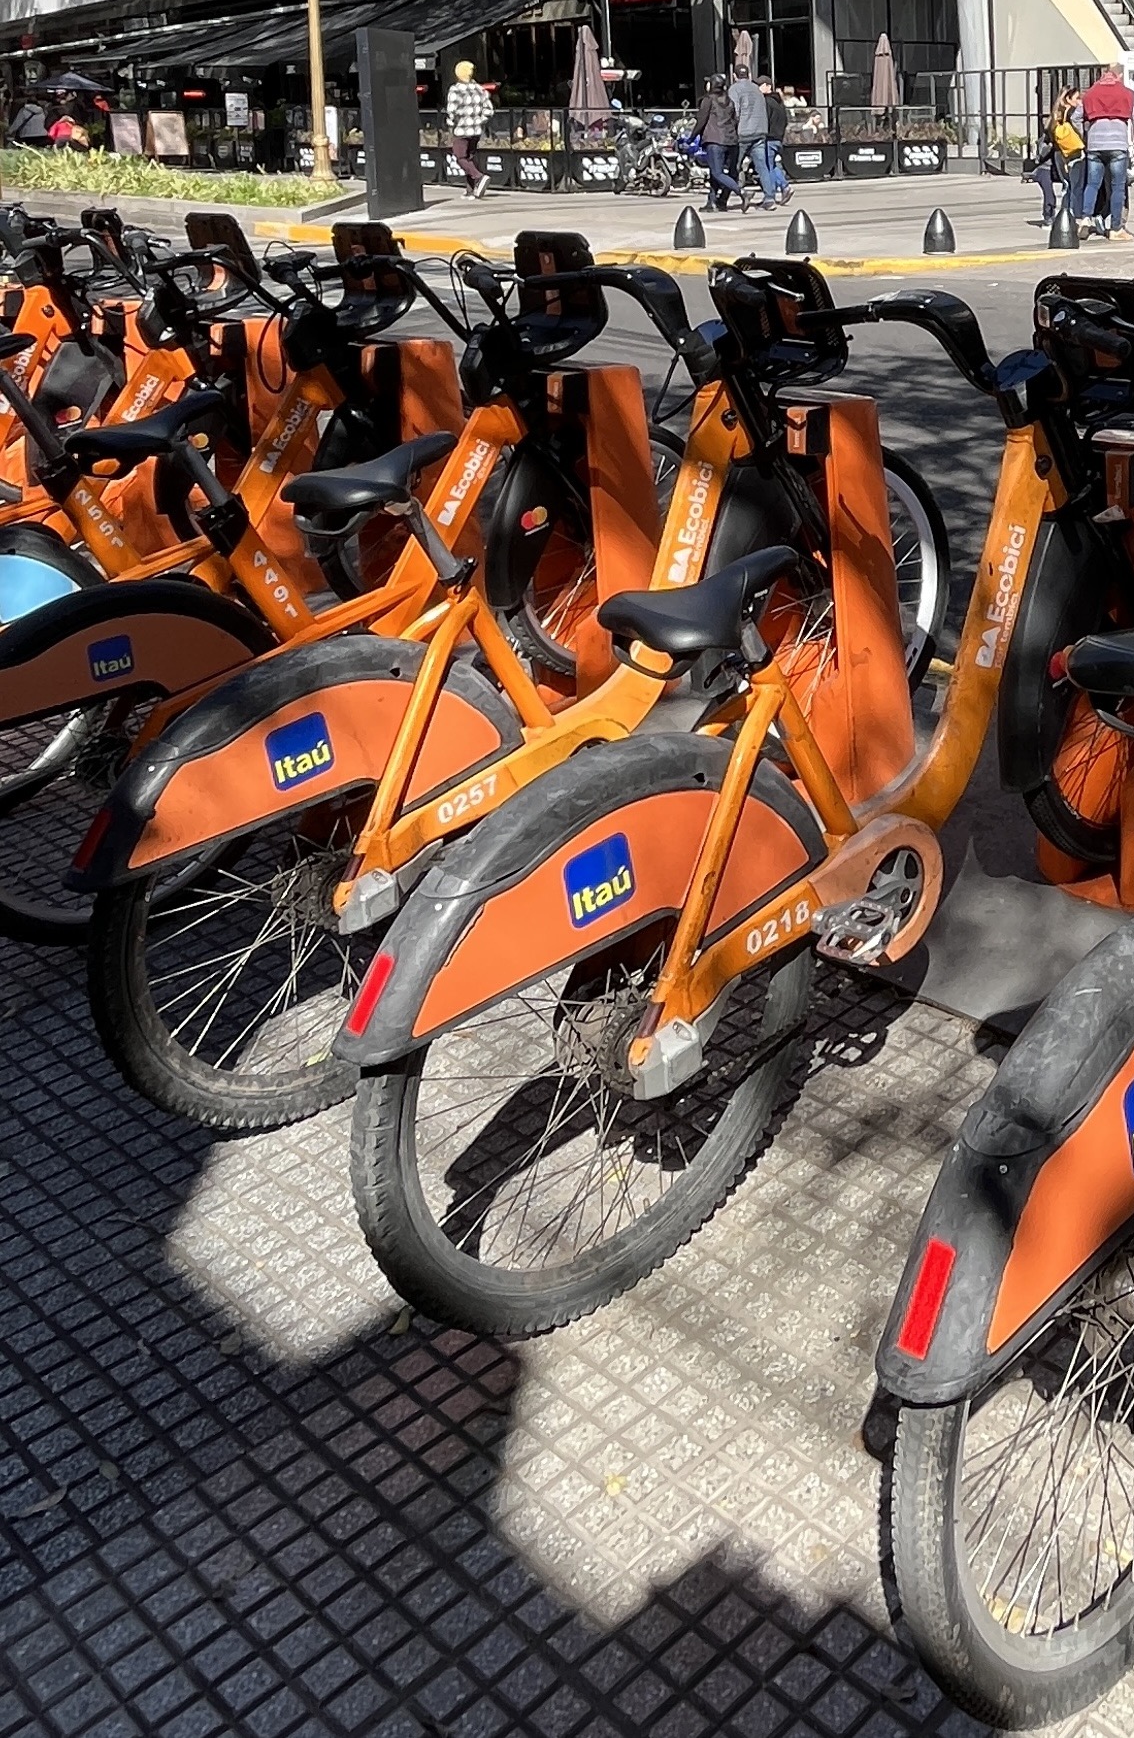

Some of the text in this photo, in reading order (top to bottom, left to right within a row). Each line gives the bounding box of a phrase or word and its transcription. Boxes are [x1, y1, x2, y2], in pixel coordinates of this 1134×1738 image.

[272, 397, 311, 451] Ecobici
[450, 438, 491, 500] Ecobici
[75, 489, 124, 548] 2551
[677, 461, 715, 547] Ecobici
[254, 550, 298, 618] 4491
[986, 523, 1027, 623] Ecobici
[93, 652, 132, 677] Itaú
[274, 740, 332, 783] Itaú
[437, 773, 498, 825] 0257
[572, 865, 631, 920] Itaú
[746, 899, 810, 955] 0218
